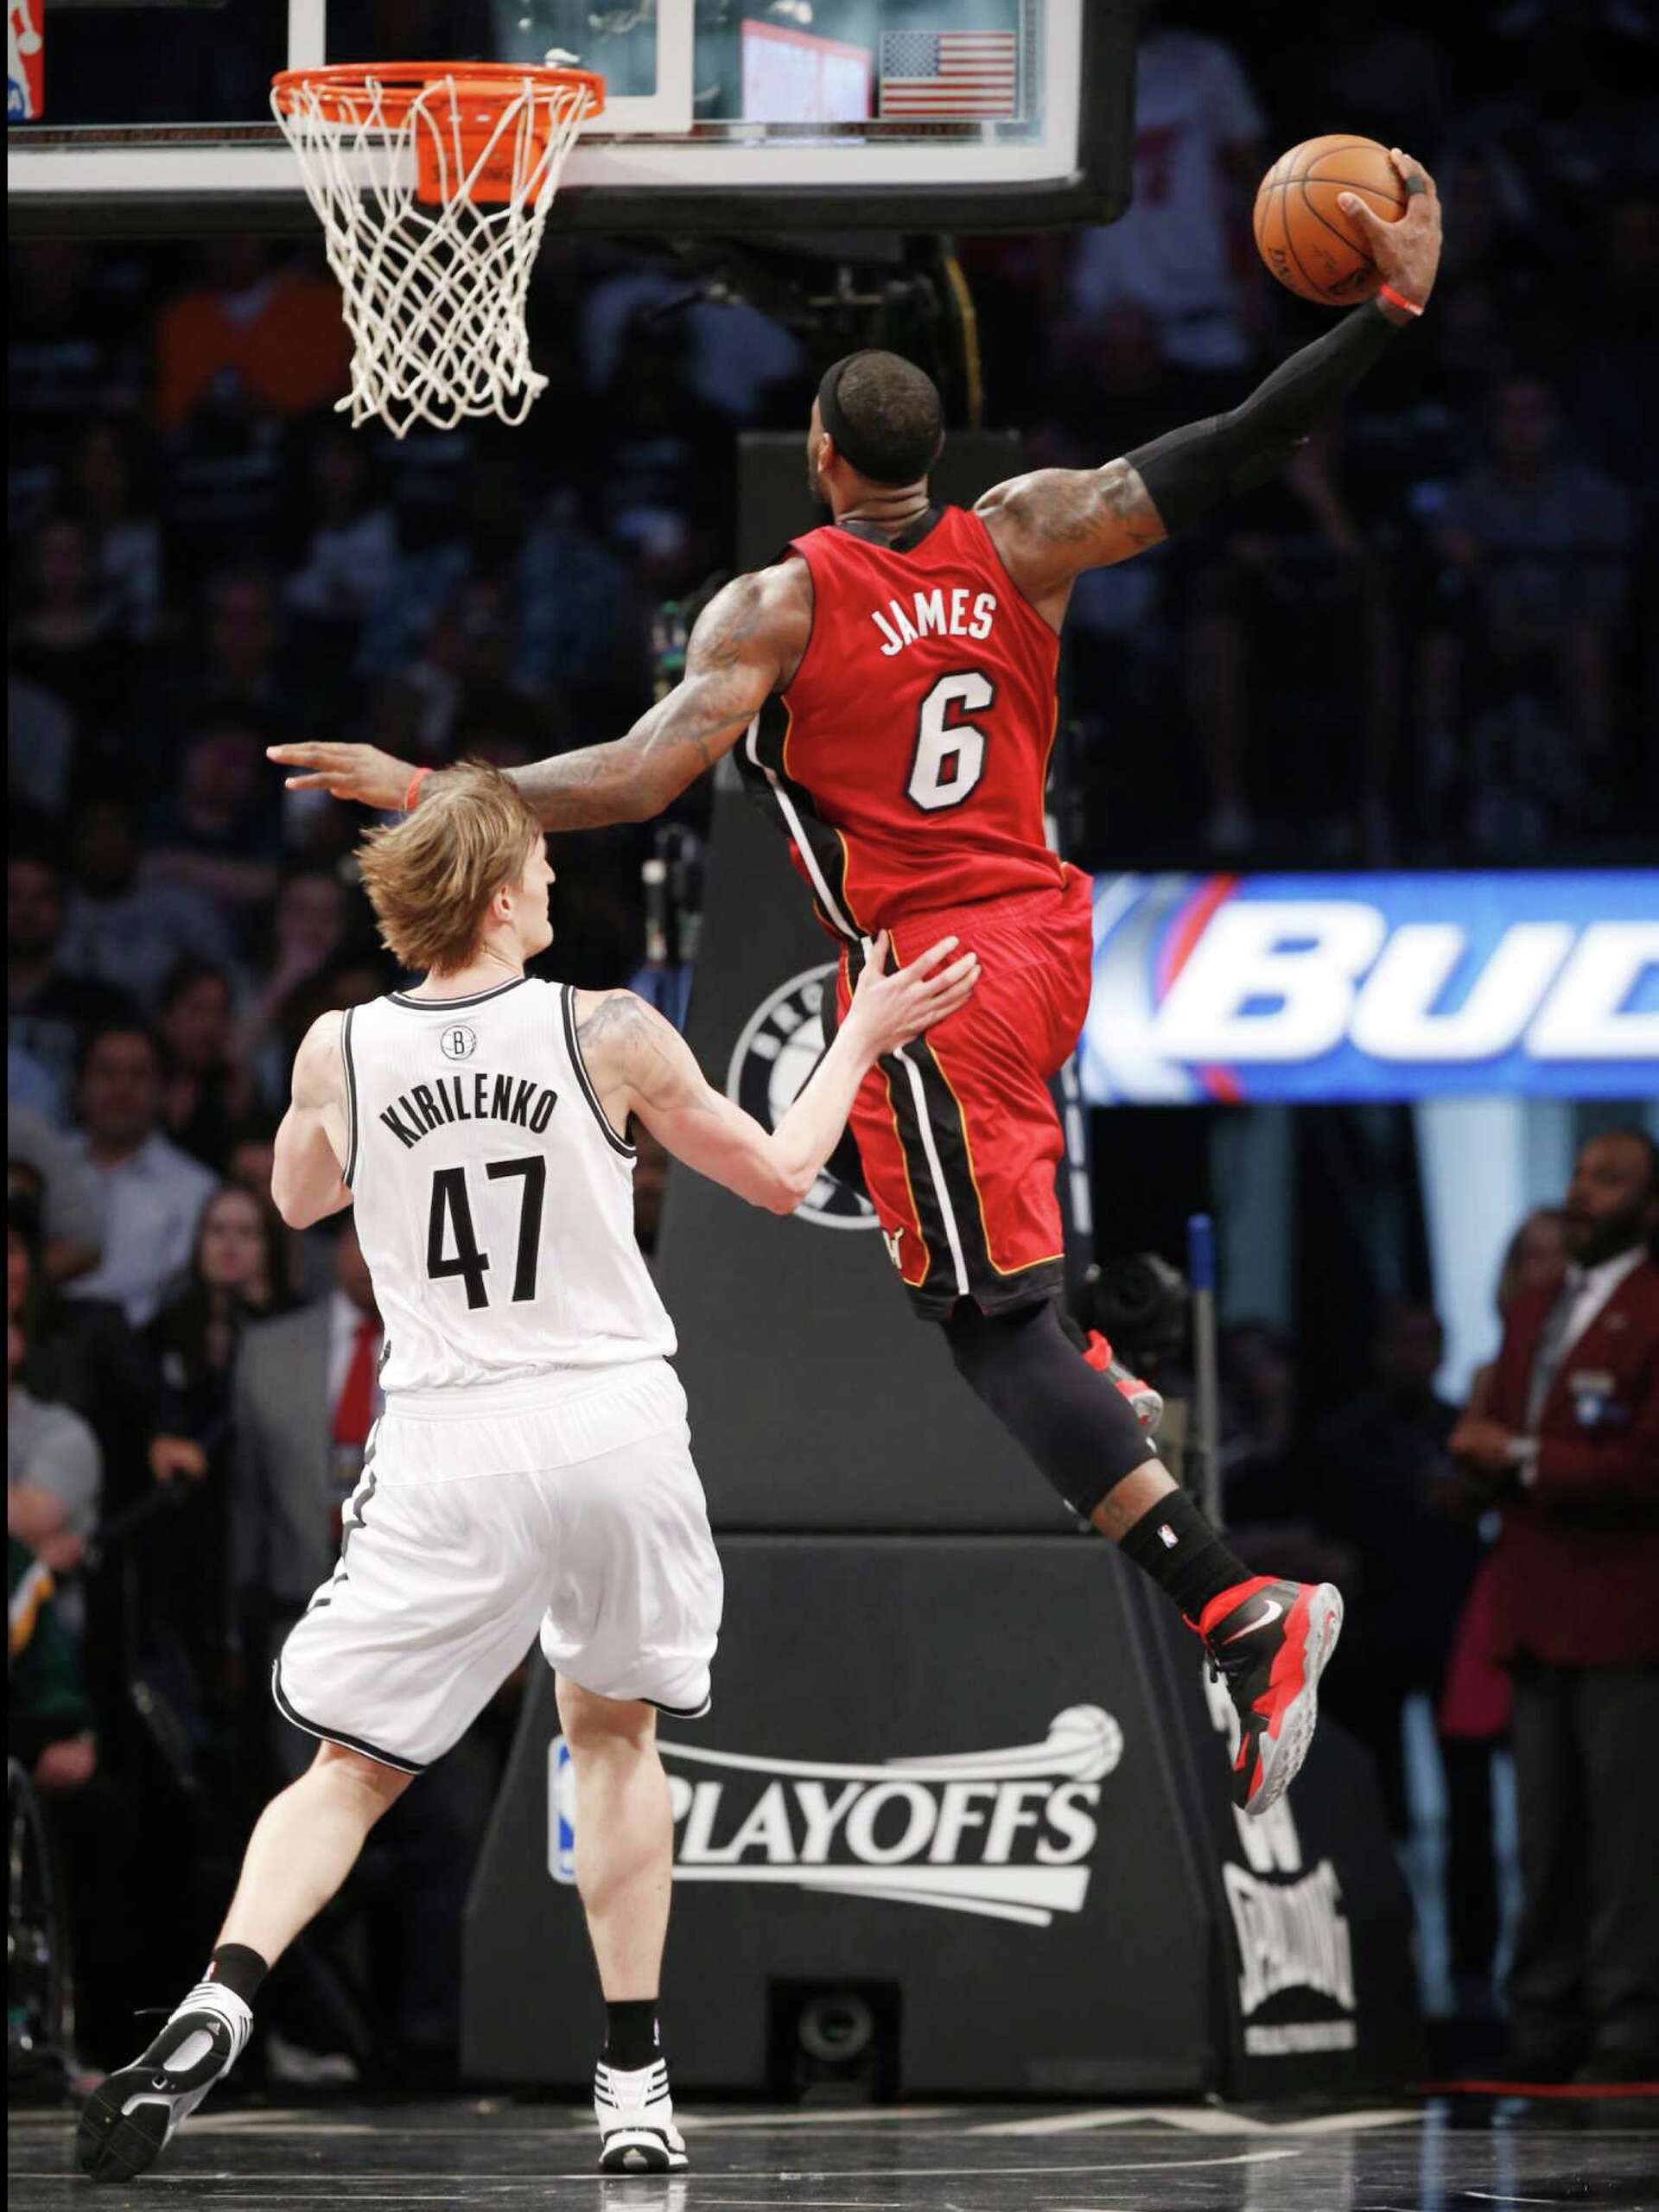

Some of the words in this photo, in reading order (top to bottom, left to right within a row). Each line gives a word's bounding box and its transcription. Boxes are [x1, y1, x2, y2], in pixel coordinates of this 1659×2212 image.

[871, 588, 997, 657] JAMES
[906, 669, 995, 812] 6
[378, 1073, 558, 1149] KIRILENKO
[427, 1155, 546, 1309] 47
